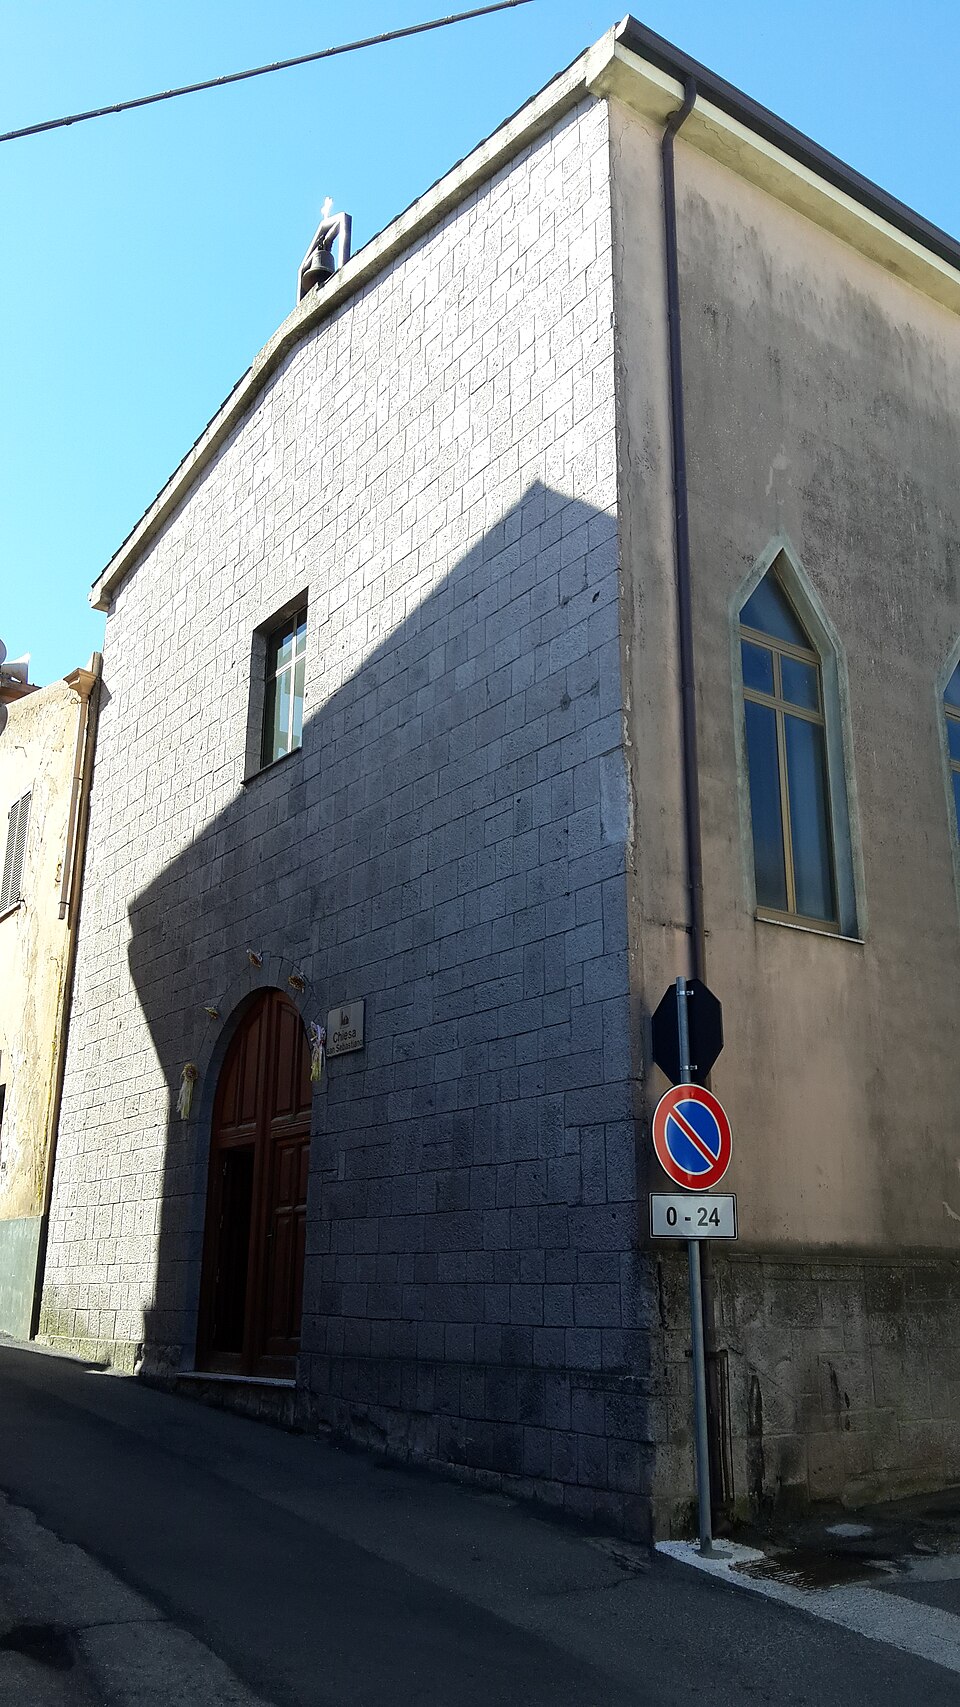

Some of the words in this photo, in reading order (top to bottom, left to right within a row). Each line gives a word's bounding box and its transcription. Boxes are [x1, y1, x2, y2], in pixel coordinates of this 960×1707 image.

[333, 1029, 356, 1043] Chiesa
[666, 1206, 677, 1226] 0
[697, 1207, 720, 1226] 24
